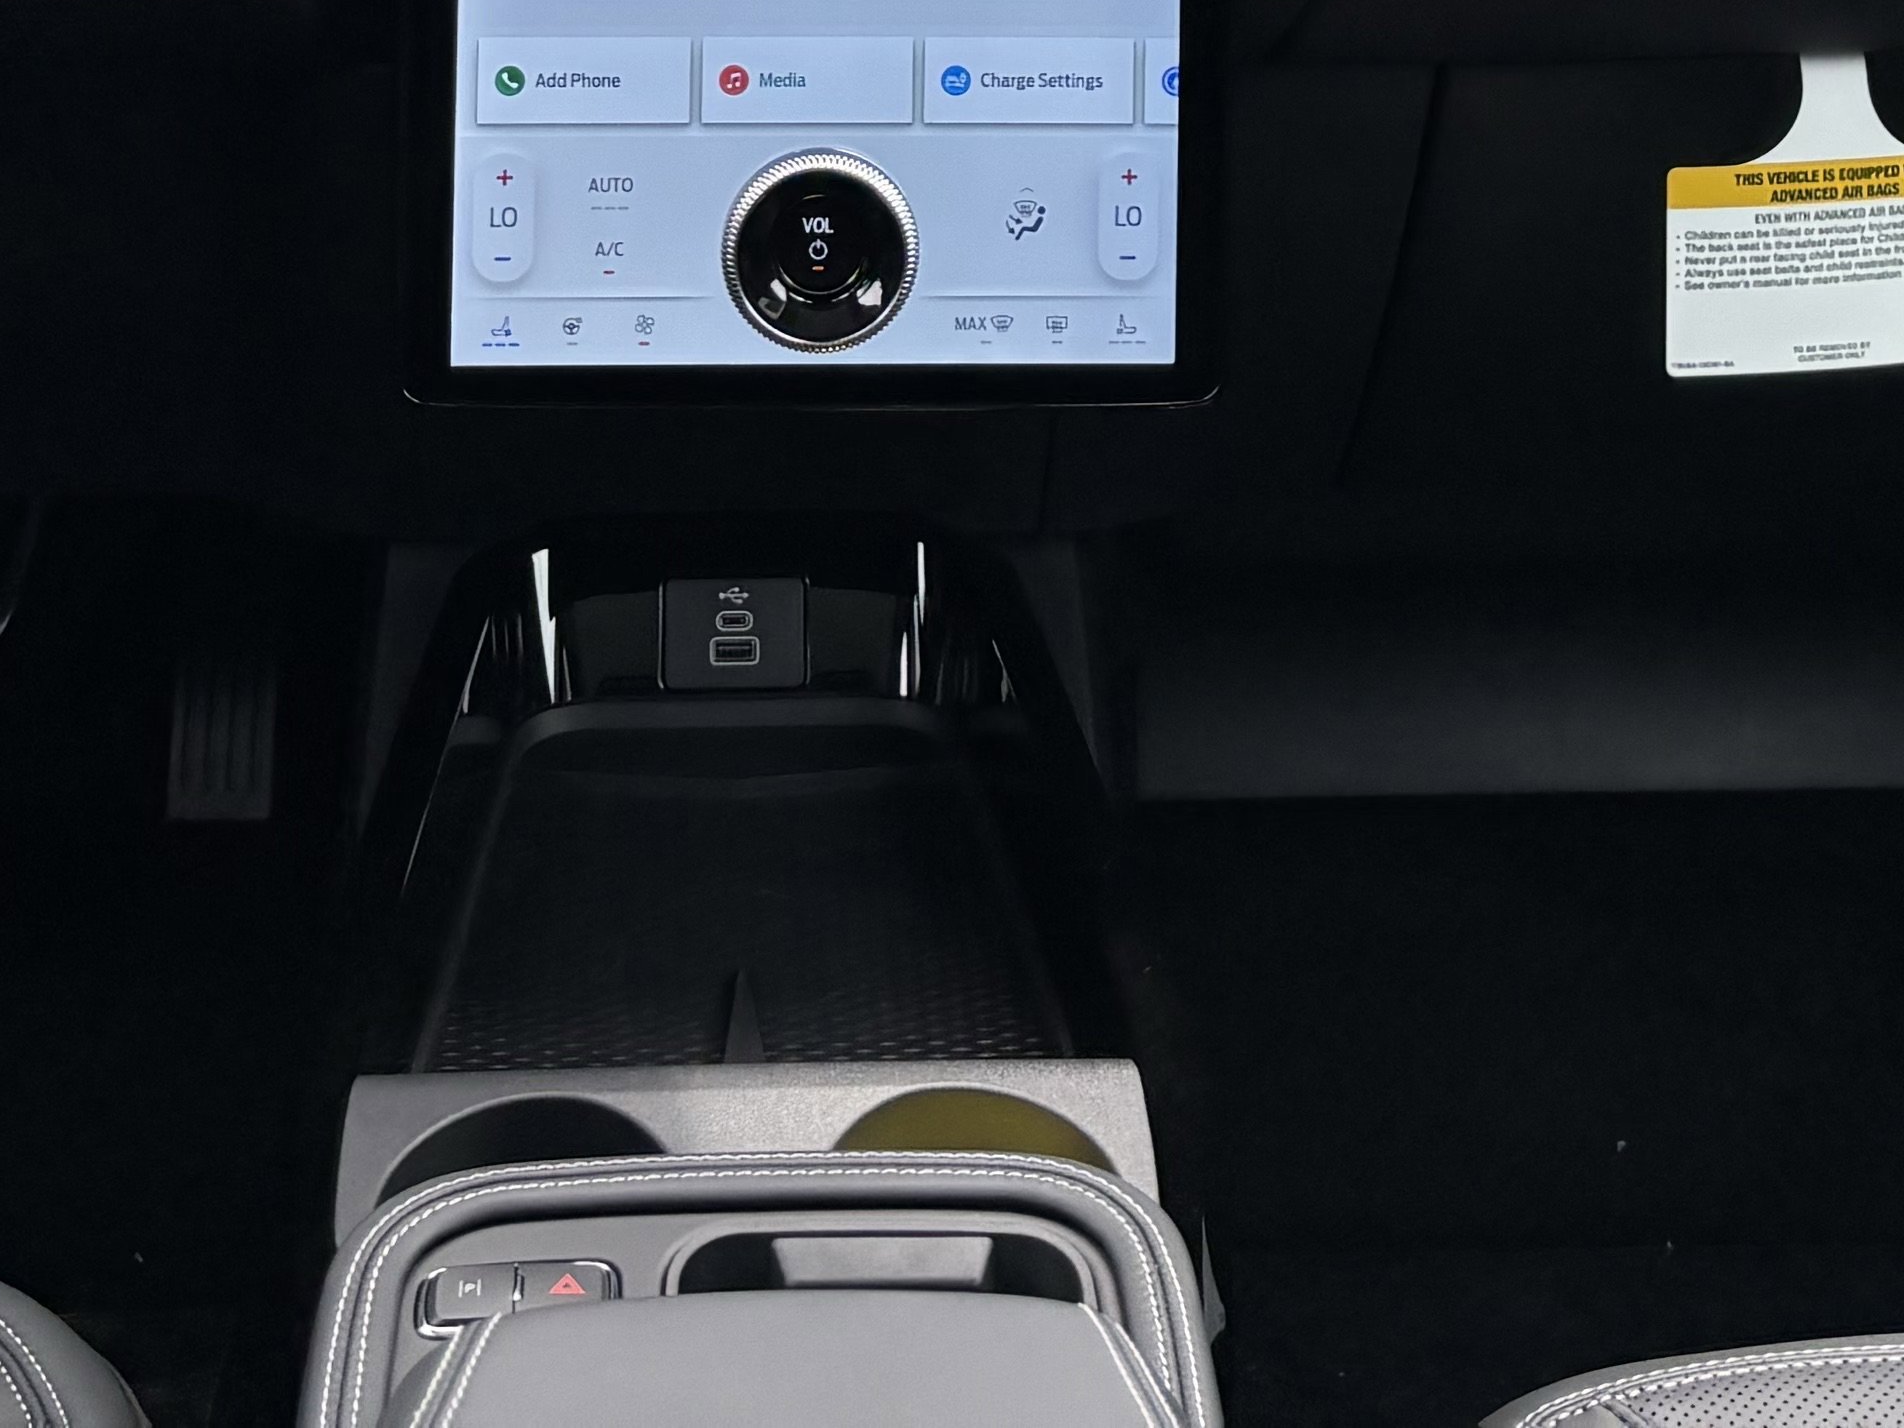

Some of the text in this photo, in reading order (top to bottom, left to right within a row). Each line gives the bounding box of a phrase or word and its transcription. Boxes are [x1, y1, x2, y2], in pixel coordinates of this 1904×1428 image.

[535, 71, 1103, 92] Add Phone Media Charge Settings
[588, 176, 634, 194] AUTO
[1735, 173, 1763, 186] THIS
[1768, 170, 1819, 185] VEHICLE
[1823, 168, 1835, 182] IS
[1839, 165, 1900, 181] EQUIPPED
[1771, 183, 1900, 203] ADVANCED AIR BAGS
[489, 206, 1142, 234] LO VOL LO
[1755, 213, 1781, 225] EVEN
[1785, 212, 1810, 222] WITH
[1814, 207, 1866, 221] ADVANCED
[1869, 206, 1886, 217] AIR
[1684, 231, 1731, 240] Children
[594, 240, 624, 258] A/C
[954, 315, 988, 332] MAX
